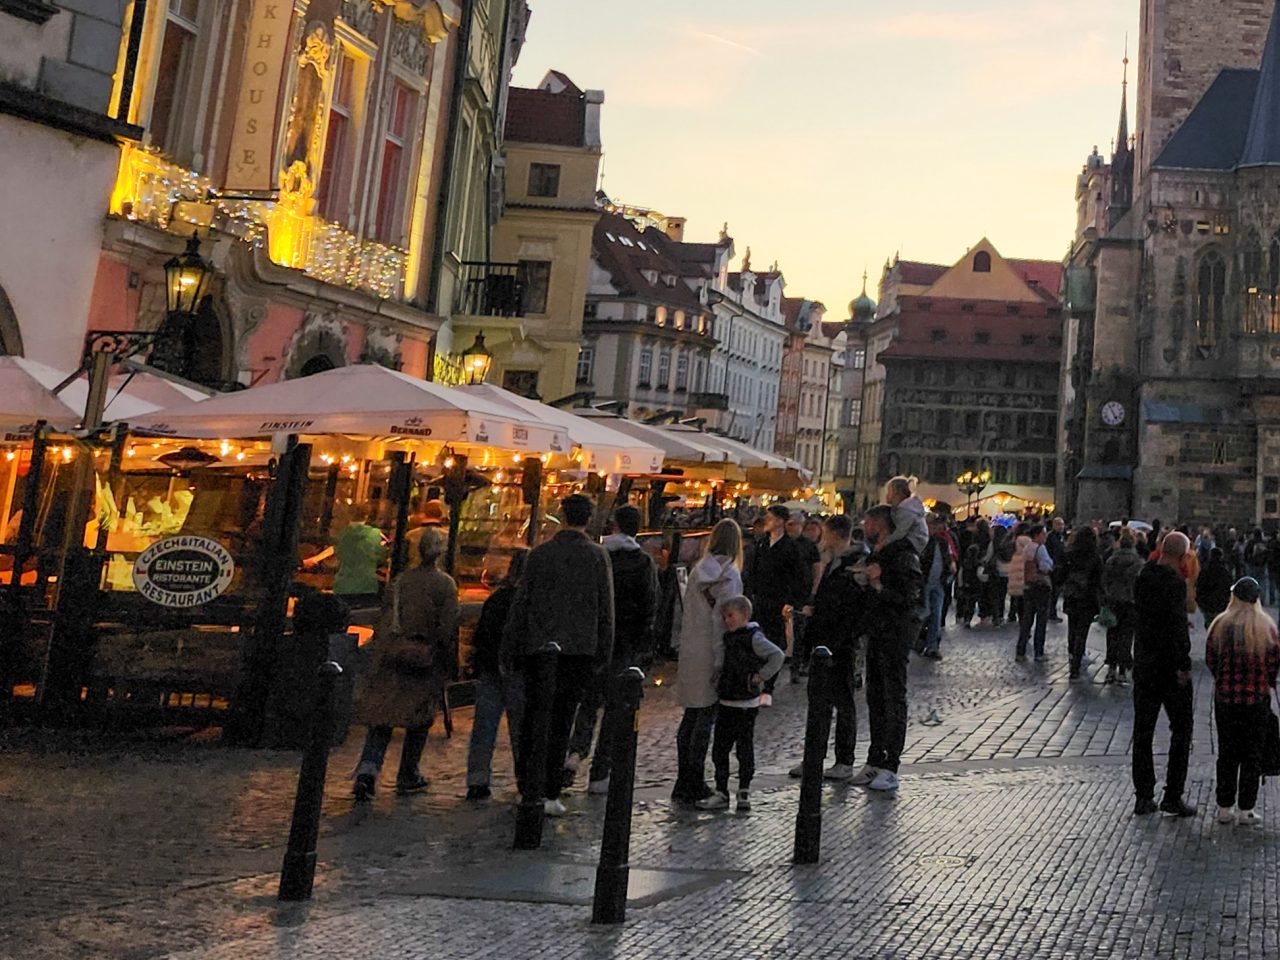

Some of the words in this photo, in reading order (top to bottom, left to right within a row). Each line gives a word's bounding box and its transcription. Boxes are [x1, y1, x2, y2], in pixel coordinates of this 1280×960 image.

[260, 420, 314, 429] EINSTEIN
[155, 560, 213, 572] EINSTEIN
[152, 573, 211, 584] RISTORANTE
[142, 581, 219, 606] RESTAURANT
